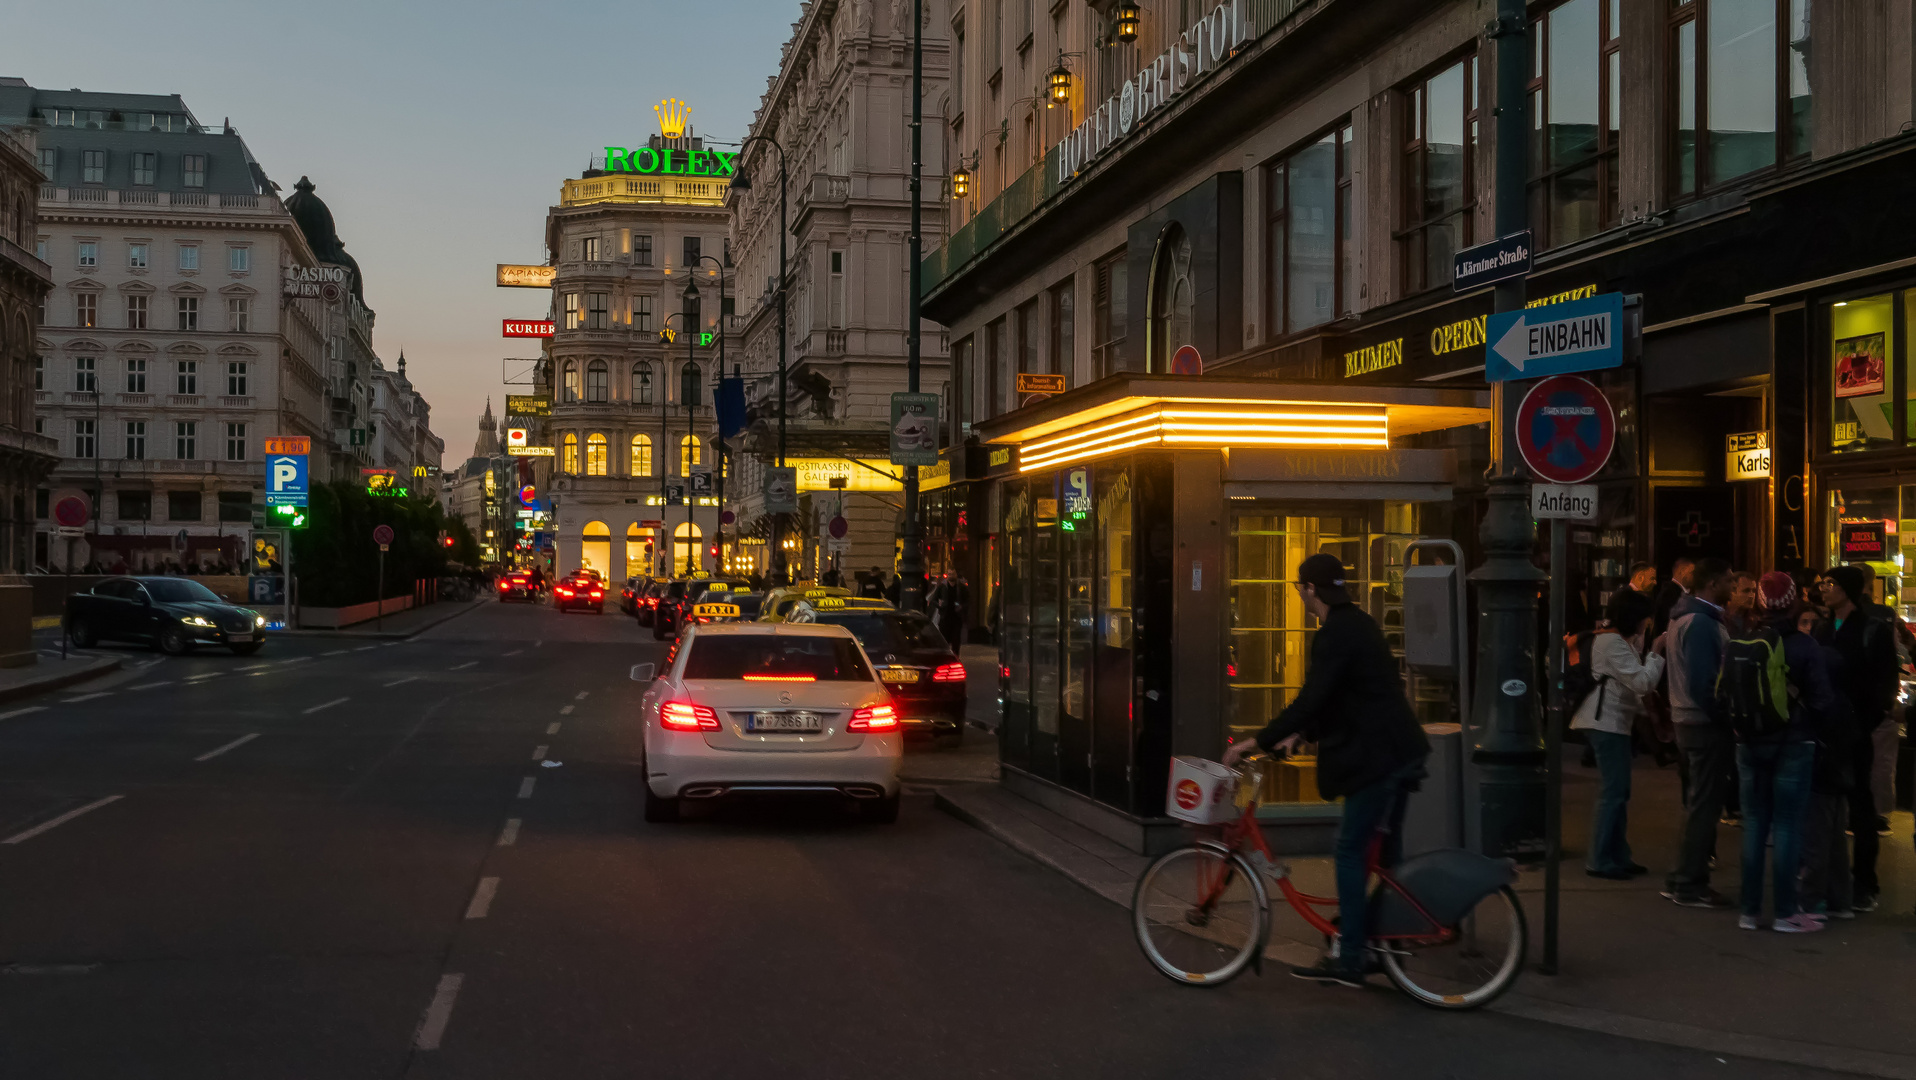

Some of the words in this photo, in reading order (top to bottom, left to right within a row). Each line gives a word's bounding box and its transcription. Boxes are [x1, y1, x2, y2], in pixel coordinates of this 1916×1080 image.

[1058, 96, 1123, 184] HOTEL
[1137, 0, 1254, 123] BRISTOL
[604, 146, 737, 176] ROLEX
[1499, 245, 1528, 266] Straße
[289, 263, 344, 282] CASINO
[290, 282, 320, 296] WIEN
[506, 323, 555, 334] KURIER
[1528, 316, 1606, 356] EINBAHN
[1344, 338, 1403, 378] BLUMEN
[1430, 314, 1488, 355] OPERN
[1737, 453, 1770, 473] Karls
[1539, 491, 1590, 516] Anfang
[703, 605, 731, 614] TAXI
